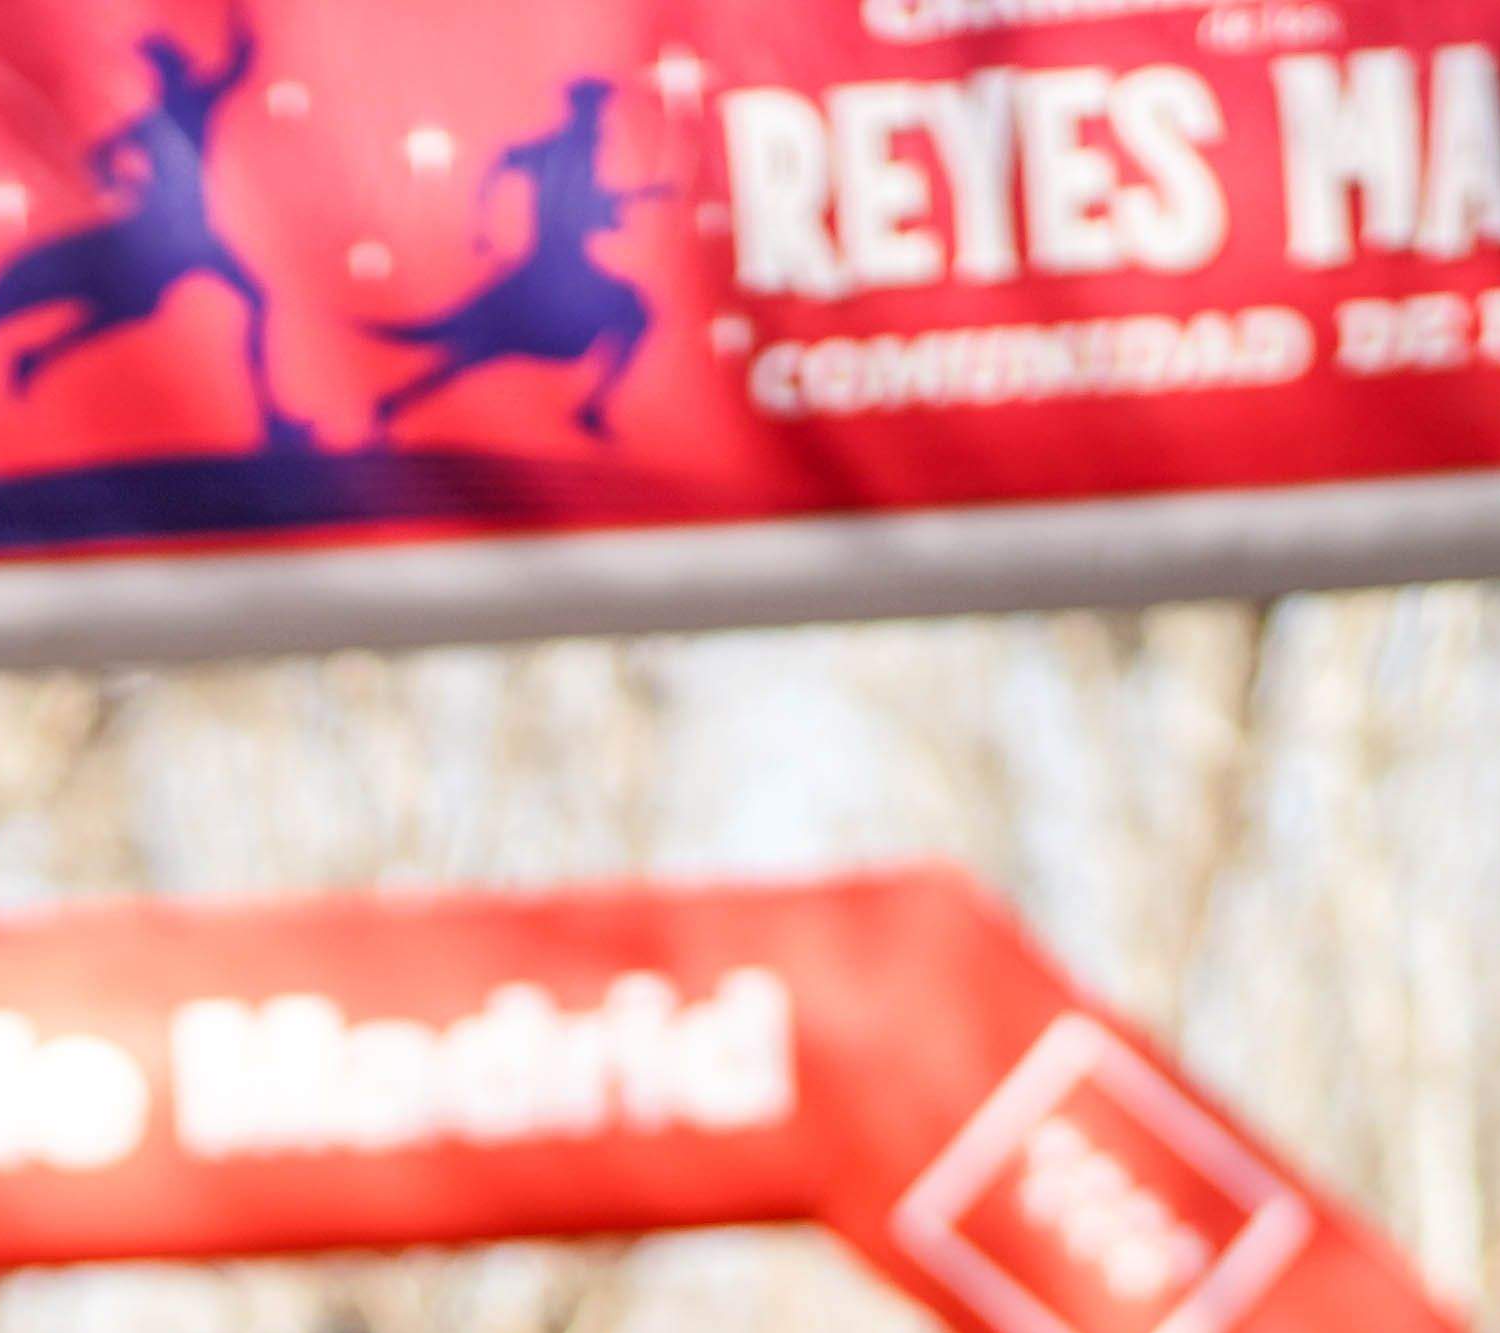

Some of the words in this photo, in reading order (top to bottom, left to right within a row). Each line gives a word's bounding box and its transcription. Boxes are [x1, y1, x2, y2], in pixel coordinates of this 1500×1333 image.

[719, 63, 1227, 300] REYES
[749, 305, 1315, 415] COMUNIDAD
[1332, 289, 1468, 374] DE
[171, 965, 793, 1156] Madrid
